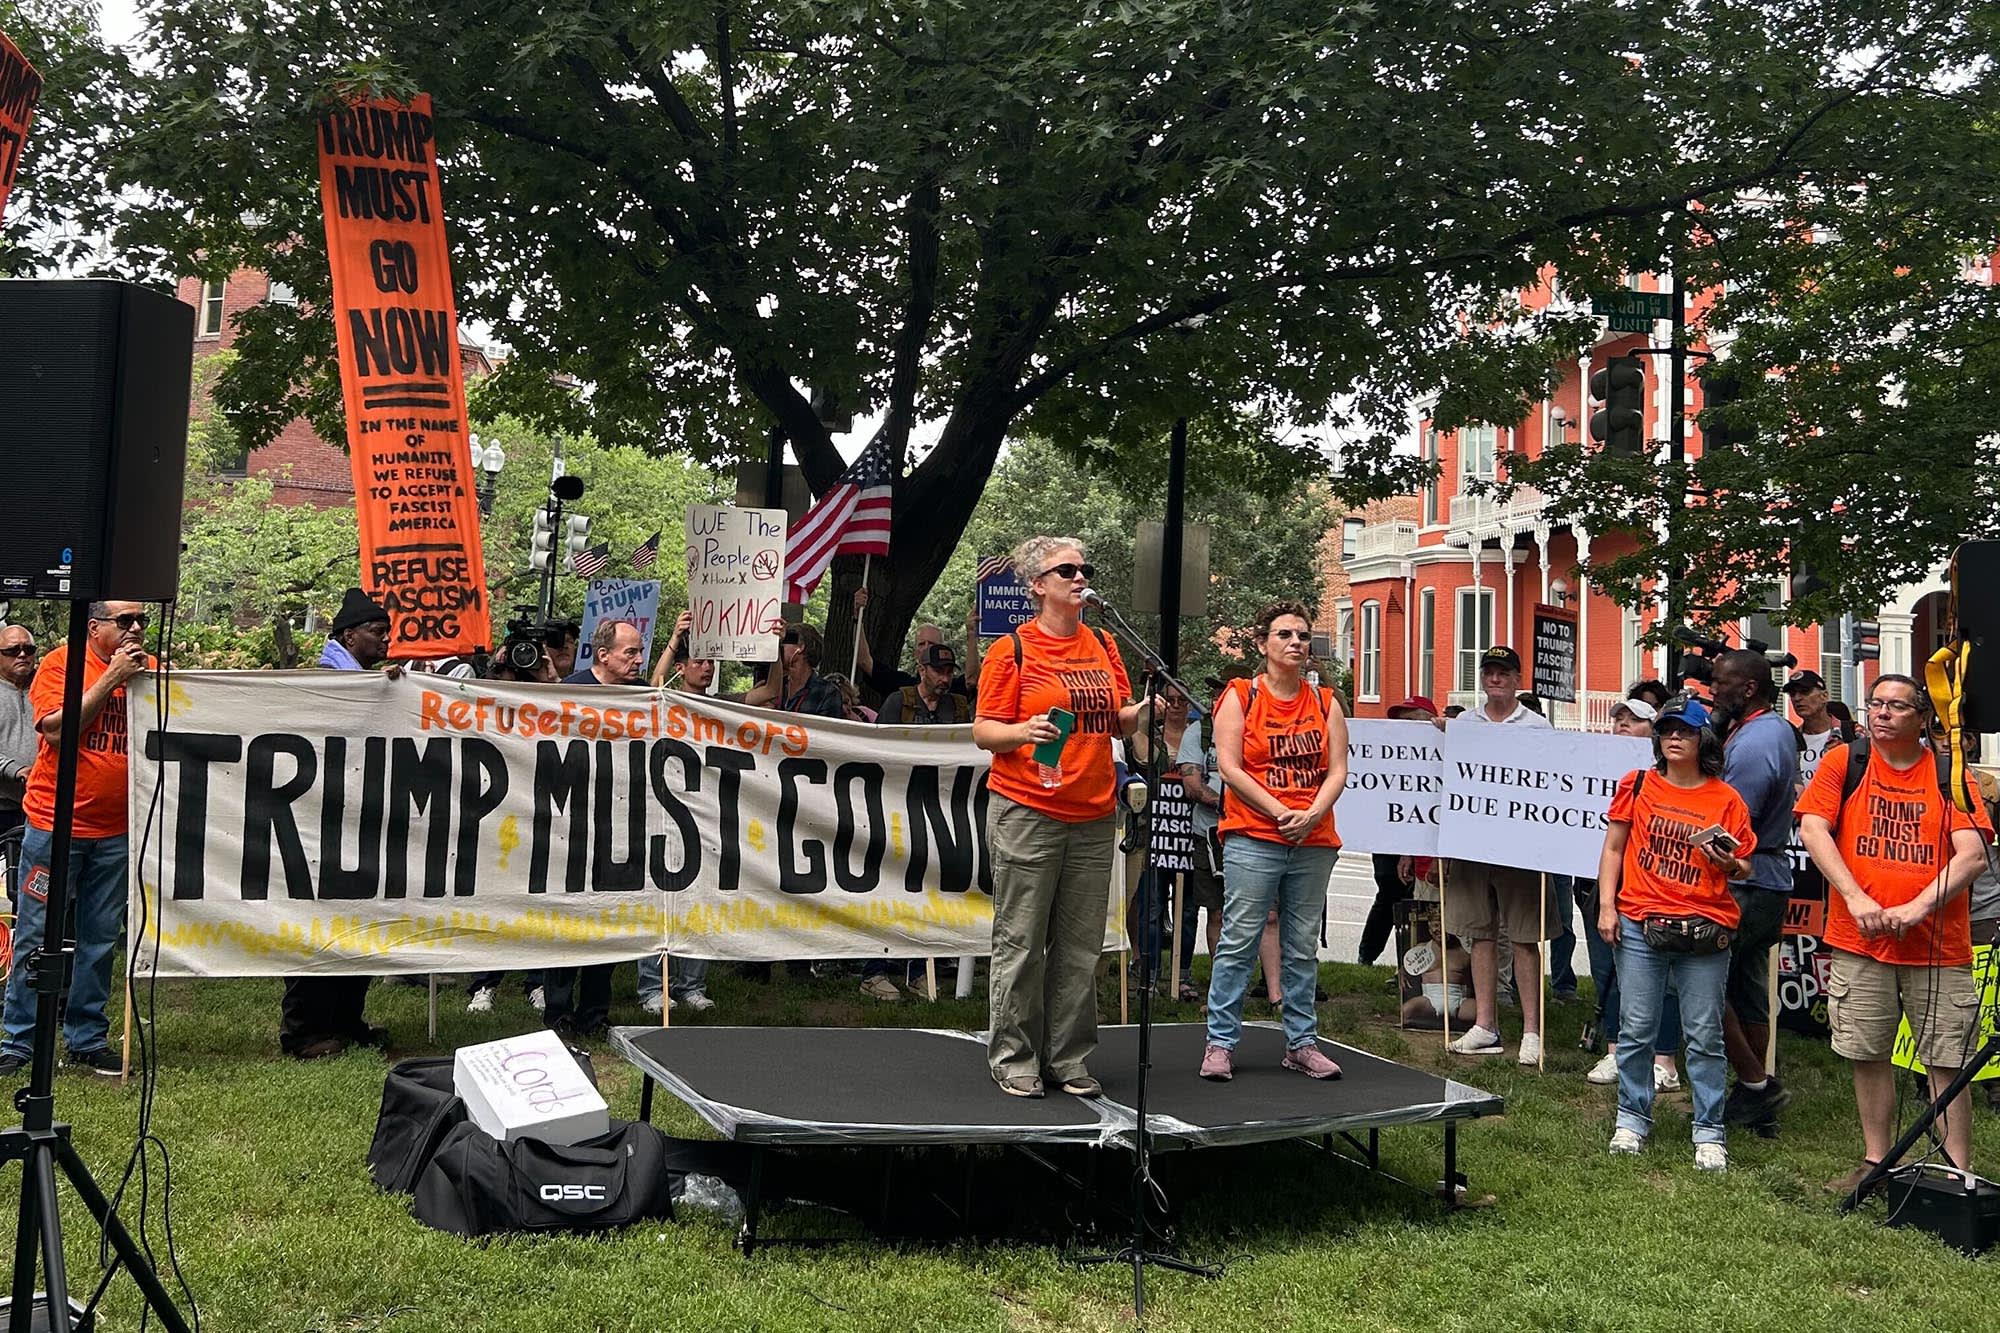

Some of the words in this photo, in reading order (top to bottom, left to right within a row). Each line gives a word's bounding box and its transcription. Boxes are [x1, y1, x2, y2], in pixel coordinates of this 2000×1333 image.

[319, 106, 432, 163] TRUMP
[335, 165, 431, 224] MUST
[370, 239, 418, 294] GO
[348, 307, 449, 377] NOW
[360, 420, 381, 433] IN
[386, 418, 416, 431] THE
[421, 419, 459, 432] NAME
[405, 434, 425, 447] OF
[372, 451, 455, 467] HUMANITY,
[374, 469, 399, 481] WE
[405, 467, 457, 481] REFUSE
[369, 486, 392, 499] TO
[398, 485, 451, 497] ACCEPT
[455, 486, 464, 497] A
[390, 501, 451, 514] FASCIST
[388, 518, 456, 531] AMERICA
[692, 510, 728, 535] WE
[744, 511, 781, 537] The
[62, 547, 72, 564] 6
[704, 538, 750, 571] People
[372, 557, 470, 588] REFUSE
[368, 586, 480, 612] FASCISM
[600, 580, 630, 596] CALL
[588, 583, 653, 617] TRUMP
[625, 604, 636, 616] A
[985, 599, 1019, 610] MAKE
[397, 614, 460, 642] .ORG
[692, 597, 714, 640] NO
[1543, 622, 1557, 635] NO
[1559, 624, 1570, 637] TO
[1537, 636, 1574, 653] TRUMP'S
[1537, 652, 1573, 669] FASCIST
[1055, 670, 1111, 688] TRUMP
[1535, 667, 1575, 685] MILITARY
[1069, 688, 1114, 711] MUST
[101, 712, 128, 734] MU
[1456, 762, 1573, 793] WHERE'S
[1161, 784, 1183, 798] NO
[145, 730, 509, 900] TRUMP
[528, 738, 756, 894] MUST
[776, 757, 886, 893] GO
[1449, 792, 1498, 816] DUE
[1869, 794, 1926, 821] TRUMP
[1872, 816, 1920, 843] MUST
[1649, 833, 1695, 863] MUST
[1856, 835, 1879, 857] GO
[1884, 839, 1934, 866] NOW!
[1638, 847, 1655, 871] GO
[1655, 856, 1703, 888] NOW!
[540, 1184, 606, 1200] QSC
